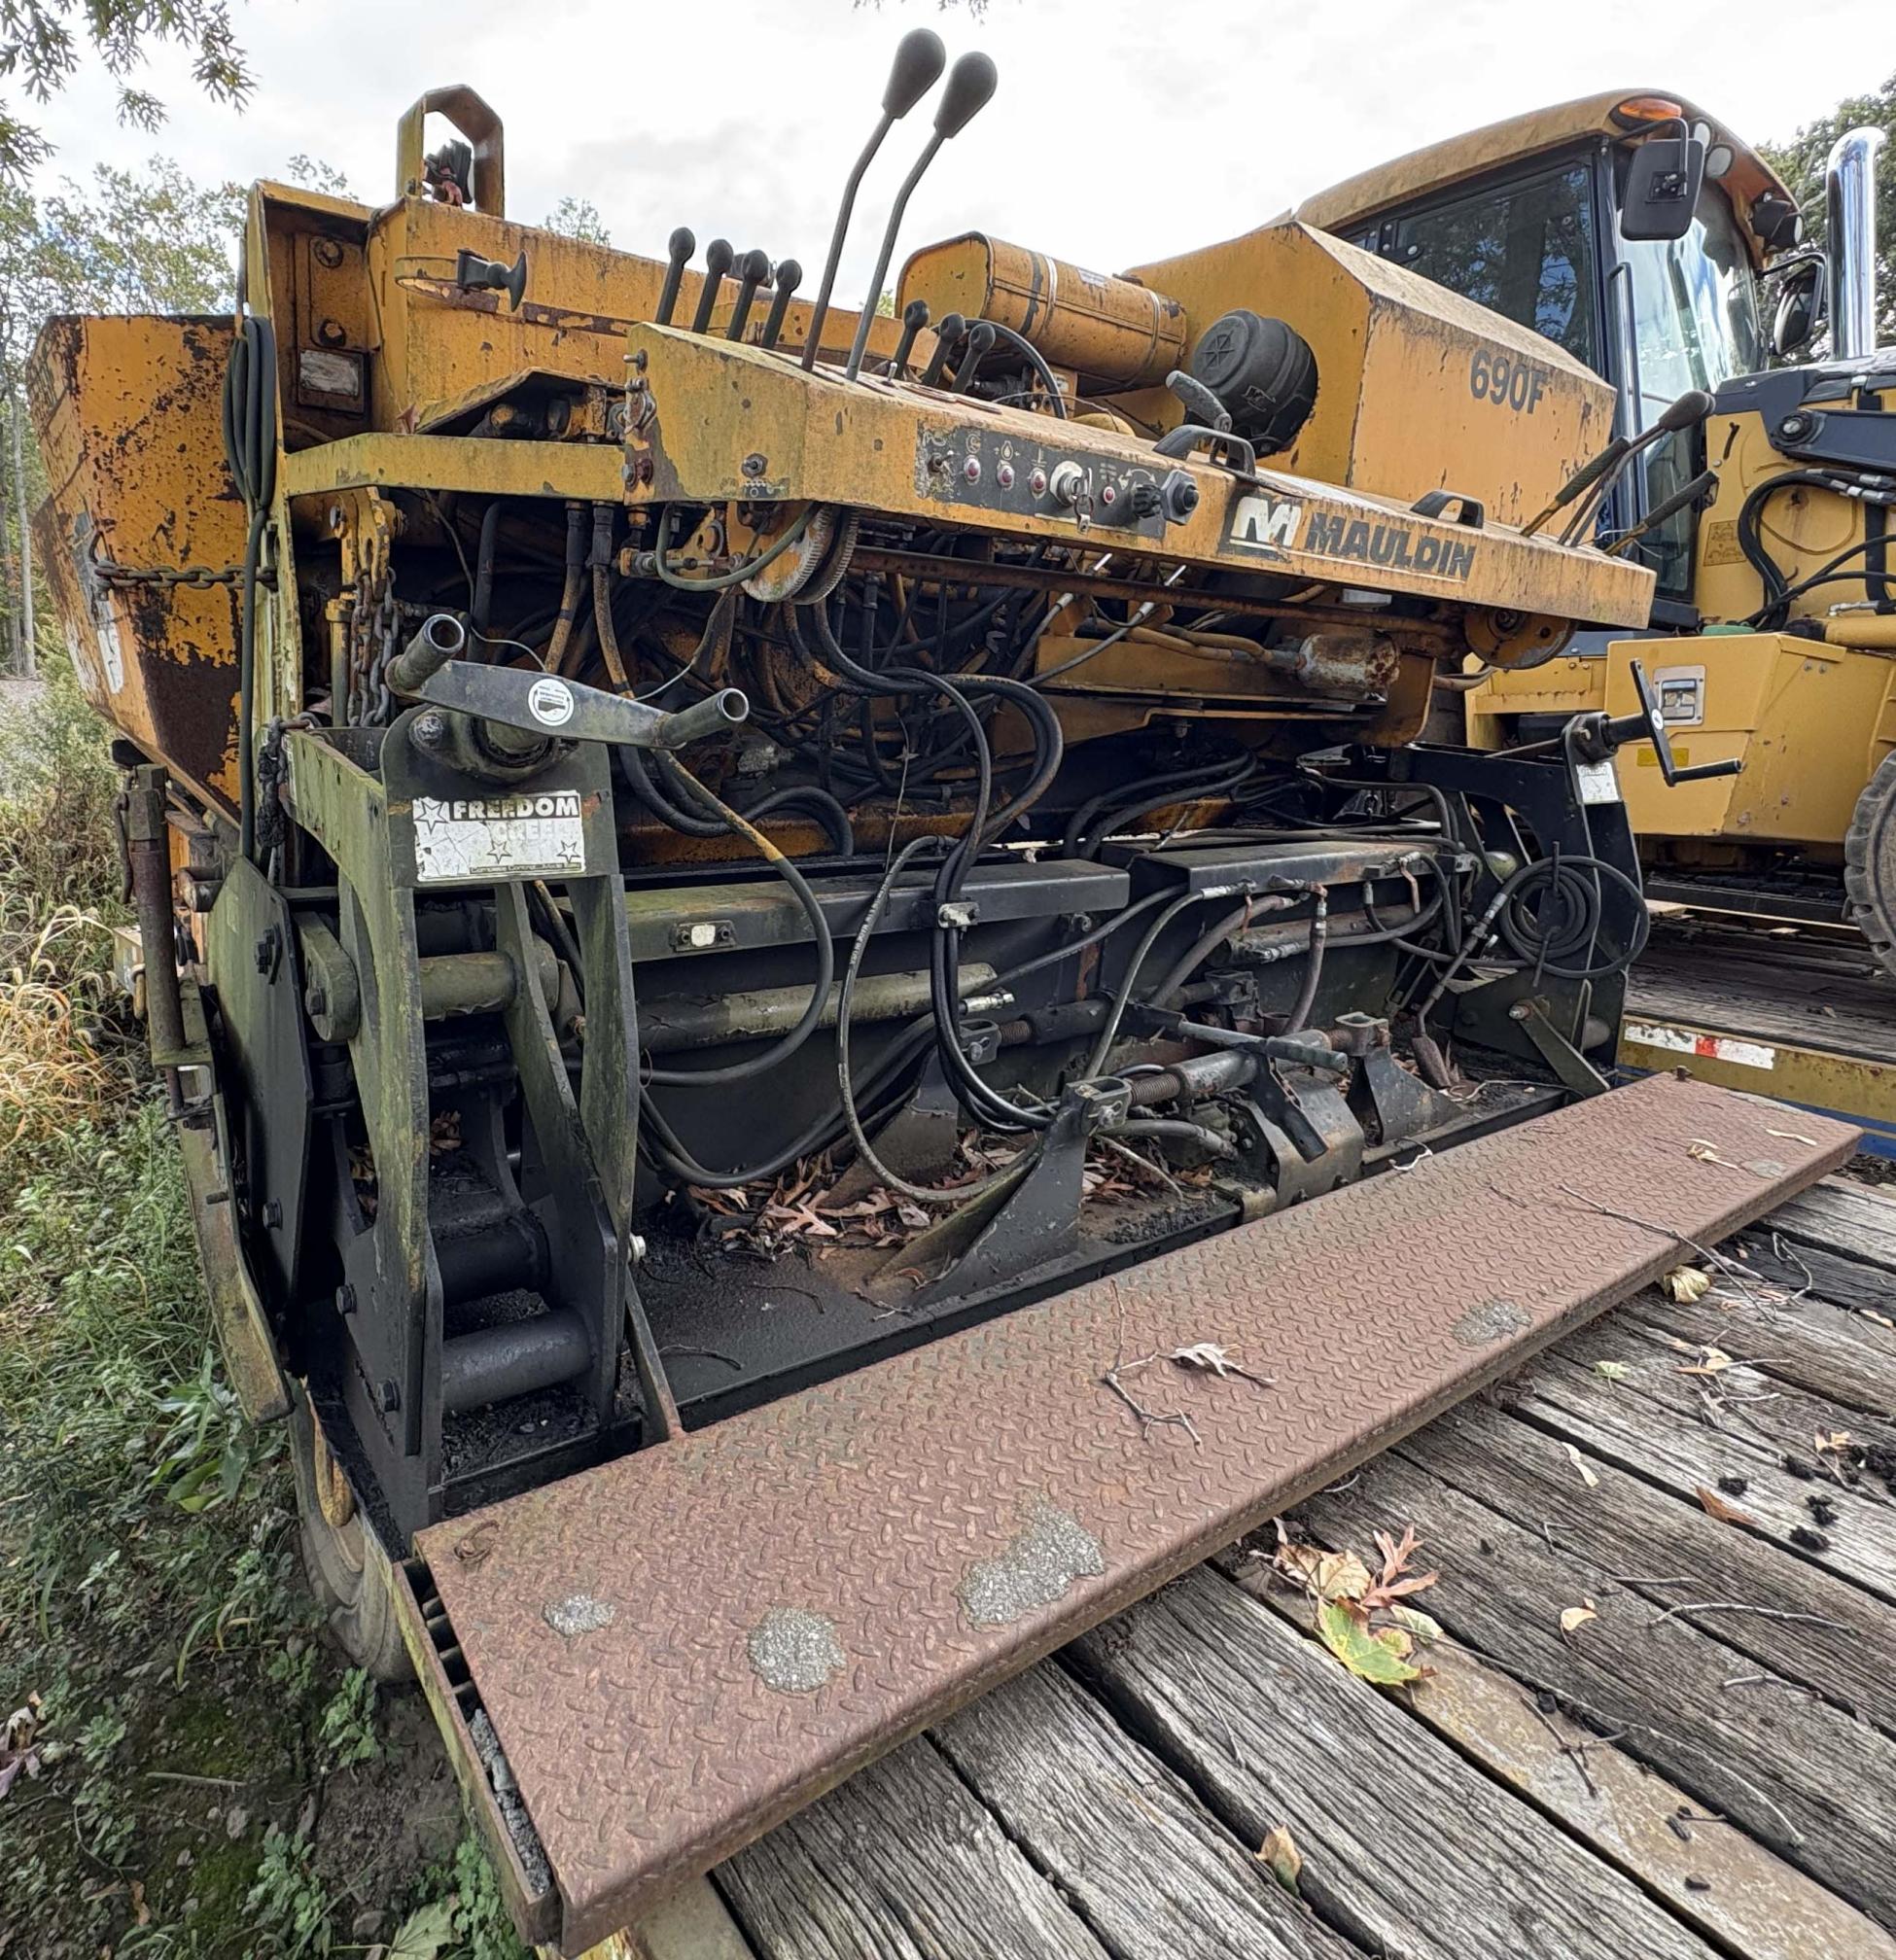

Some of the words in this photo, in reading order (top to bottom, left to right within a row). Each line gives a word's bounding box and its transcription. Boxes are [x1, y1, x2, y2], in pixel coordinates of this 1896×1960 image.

[1470, 349, 1548, 414] 690F
[1306, 512, 1476, 579] MAULDIN
[453, 796, 579, 820] FREEDOM
